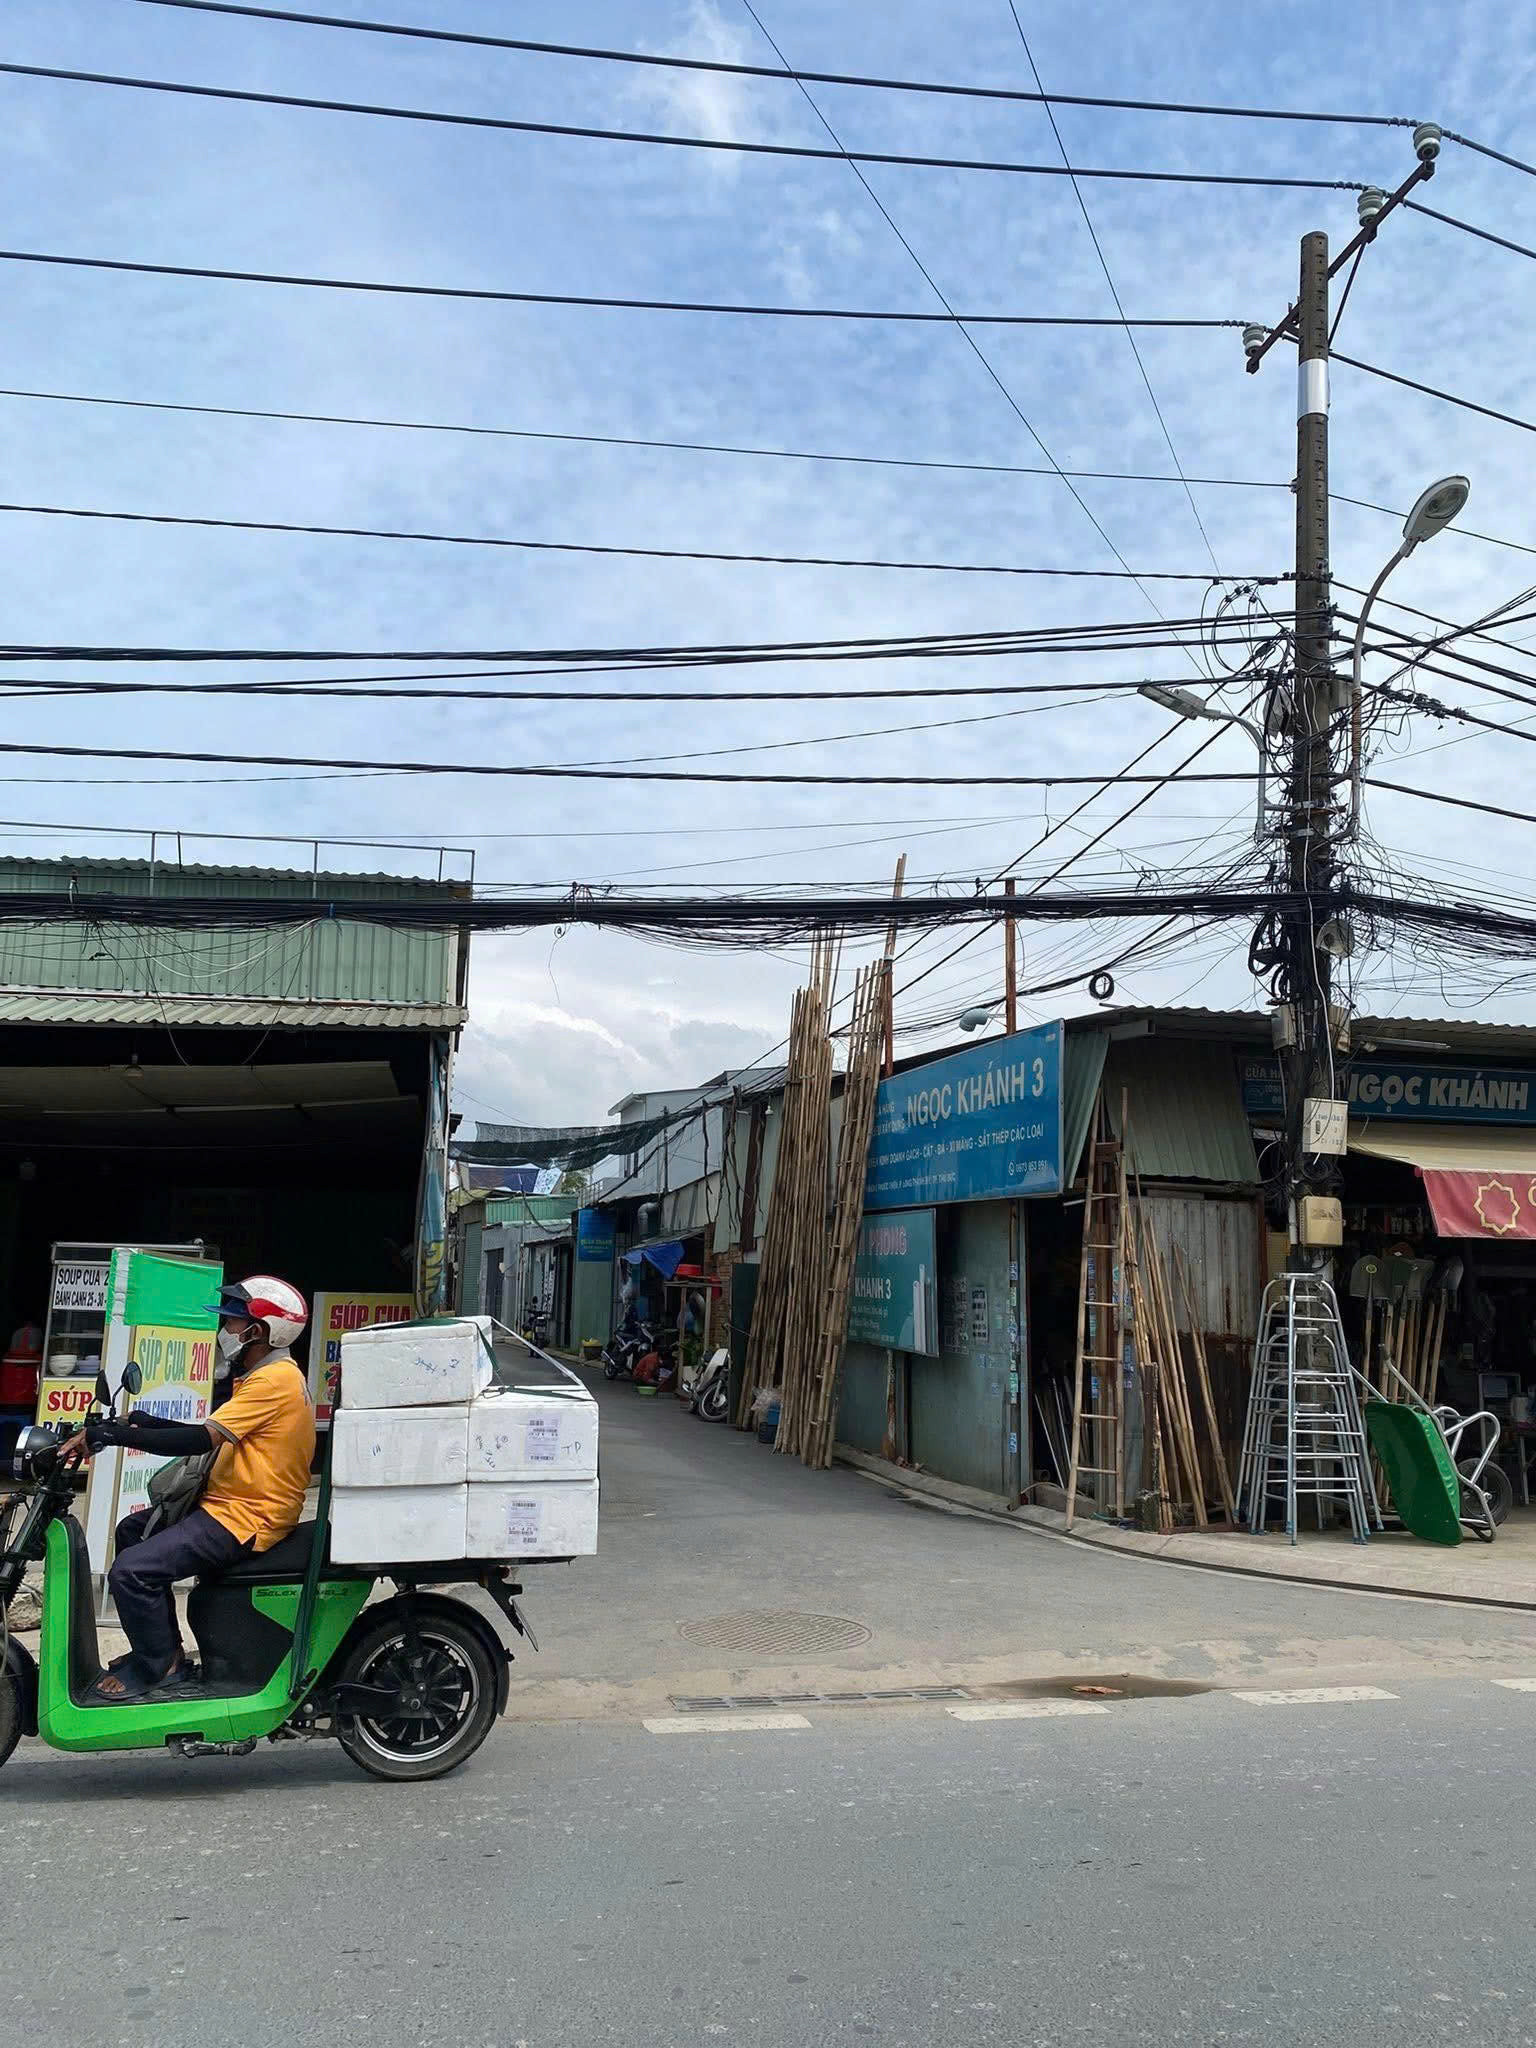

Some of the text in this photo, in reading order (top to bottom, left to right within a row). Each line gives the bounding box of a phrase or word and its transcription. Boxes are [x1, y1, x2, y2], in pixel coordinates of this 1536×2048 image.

[907, 1057, 1045, 1128] NGỌC KHÁNH 3
[1428, 1071, 1529, 1110] KHÁNH
[57, 1268, 82, 1286] SOUP
[83, 1269, 100, 1286] CUA
[885, 1278, 892, 1300] 3
[55, 1286, 71, 1306] BÁNH
[71, 1291, 87, 1307] CANH
[330, 1300, 369, 1330] SÚP
[138, 1330, 212, 1382] SÚP CUA 20K
[47, 1385, 93, 1412] SÚP
